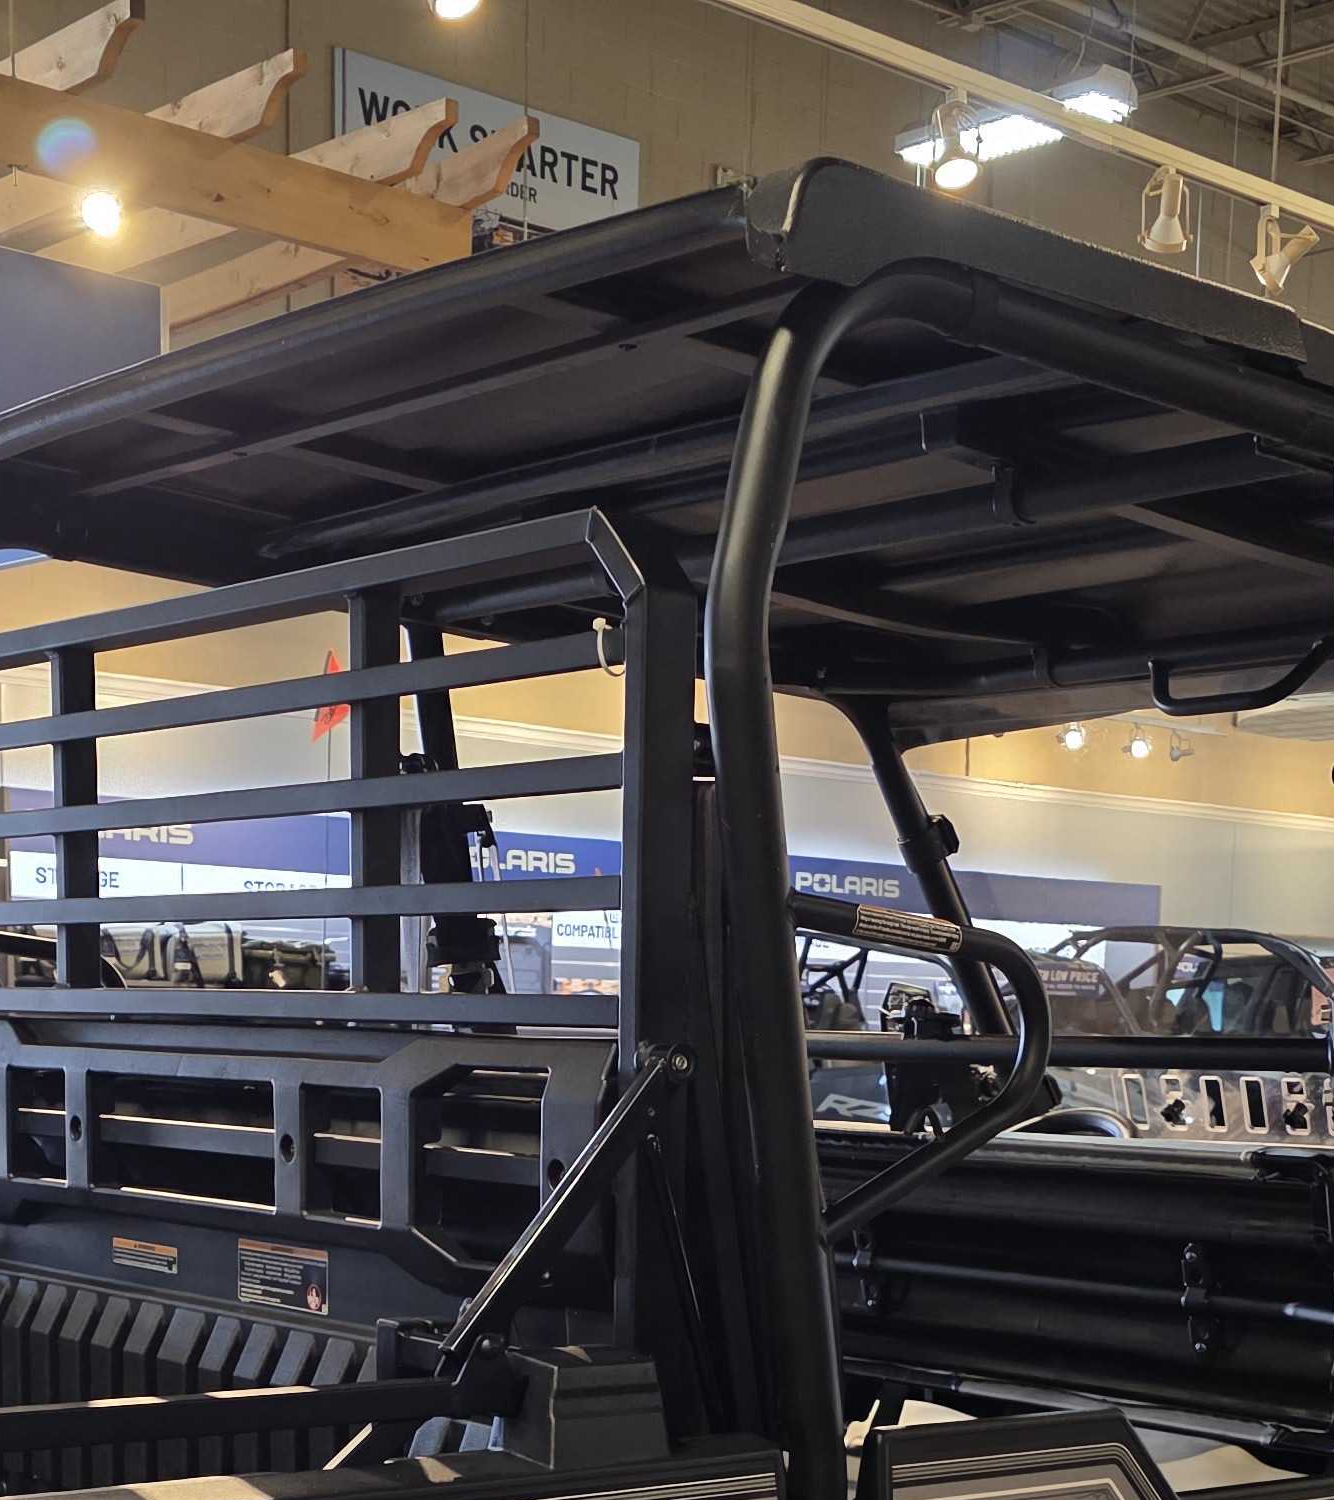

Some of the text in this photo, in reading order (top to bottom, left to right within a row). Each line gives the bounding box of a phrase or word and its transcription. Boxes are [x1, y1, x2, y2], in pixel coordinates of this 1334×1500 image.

[795, 871, 900, 898] POLARIS
[557, 923, 620, 939] COMPATIBL
[1050, 969, 1068, 982] LOW
[1069, 971, 1100, 983] PRICE
